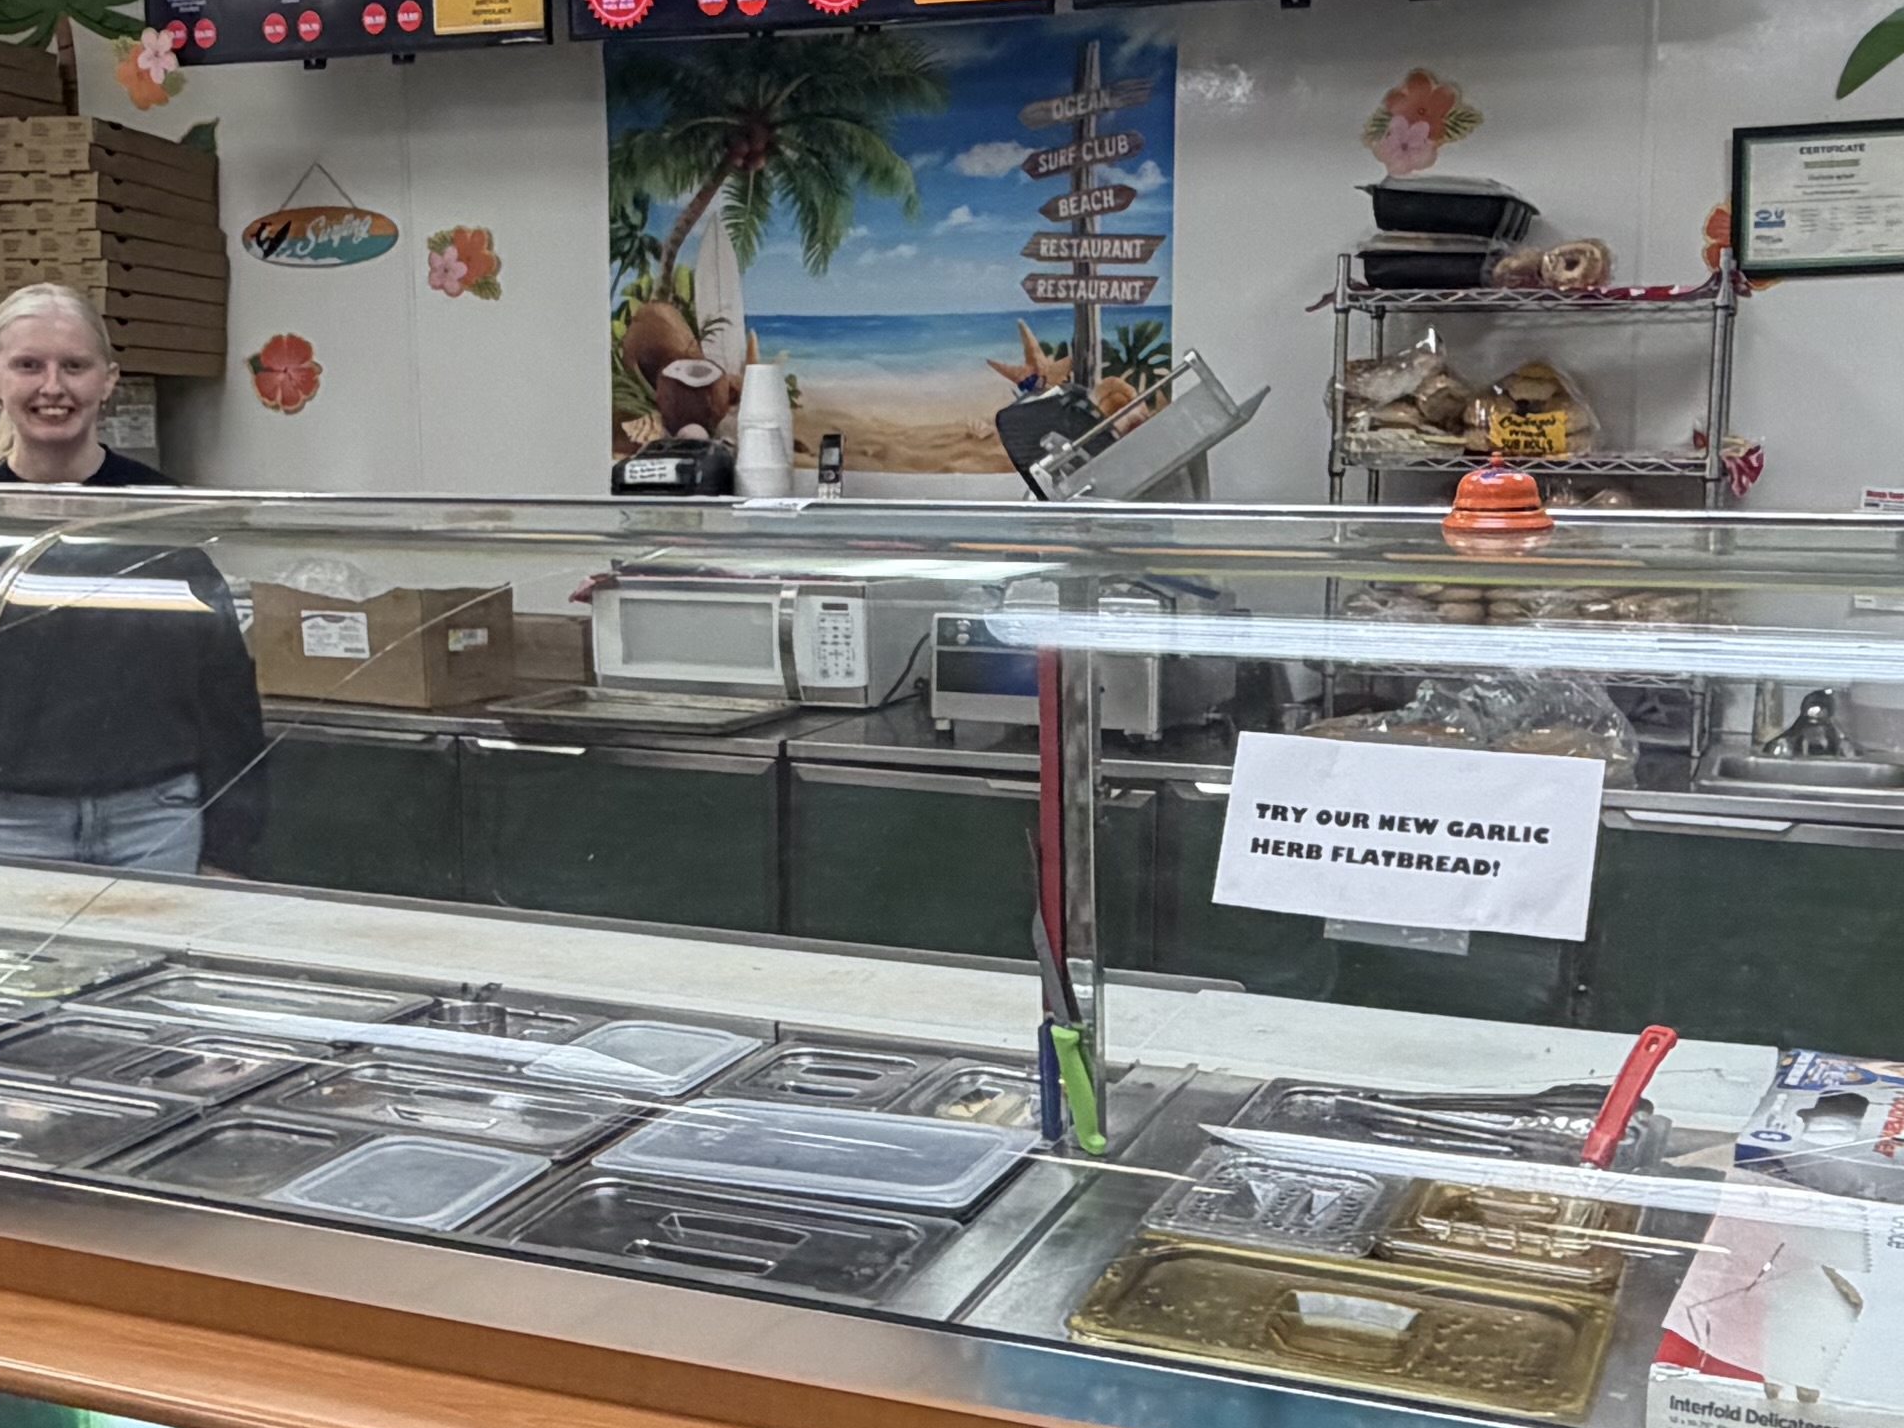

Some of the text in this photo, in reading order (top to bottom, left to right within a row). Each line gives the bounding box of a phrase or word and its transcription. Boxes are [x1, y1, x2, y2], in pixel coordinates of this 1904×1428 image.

[1051, 89, 1111, 120] OCEAN
[1038, 134, 1130, 174] SURF CLUB
[1799, 143, 1866, 156] CERTIFICATE
[1058, 188, 1116, 218] BEACH
[1039, 237, 1146, 259] RESTAURANT
[1036, 279, 1145, 301] RESTAURANT
[1255, 802, 1551, 845] TRY OUR NEW GARLIC
[1250, 837, 1502, 877] HERB FLATBREAD!
[1668, 1394, 1742, 1422] Interfold
